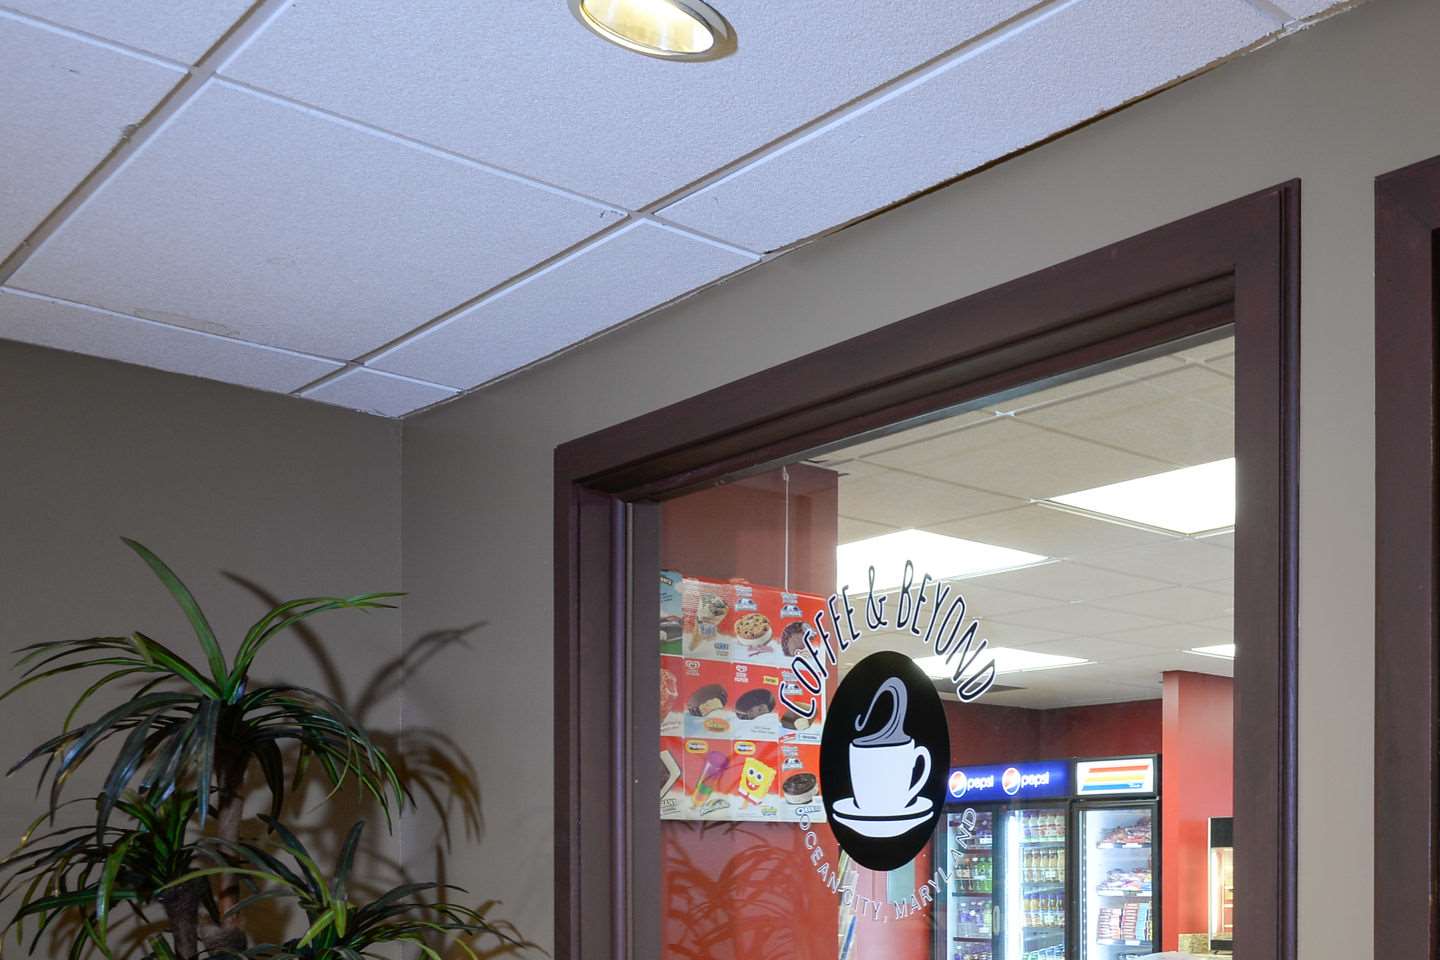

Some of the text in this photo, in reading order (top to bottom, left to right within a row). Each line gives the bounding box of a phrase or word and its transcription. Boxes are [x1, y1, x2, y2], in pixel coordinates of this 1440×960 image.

[778, 559, 997, 719] COFFEE & BEYOND
[967, 775, 995, 791] pepsi
[1021, 772, 1050, 788] pepsi
[800, 814, 840, 894] OCEAN
[894, 807, 977, 920] MARYLAND
